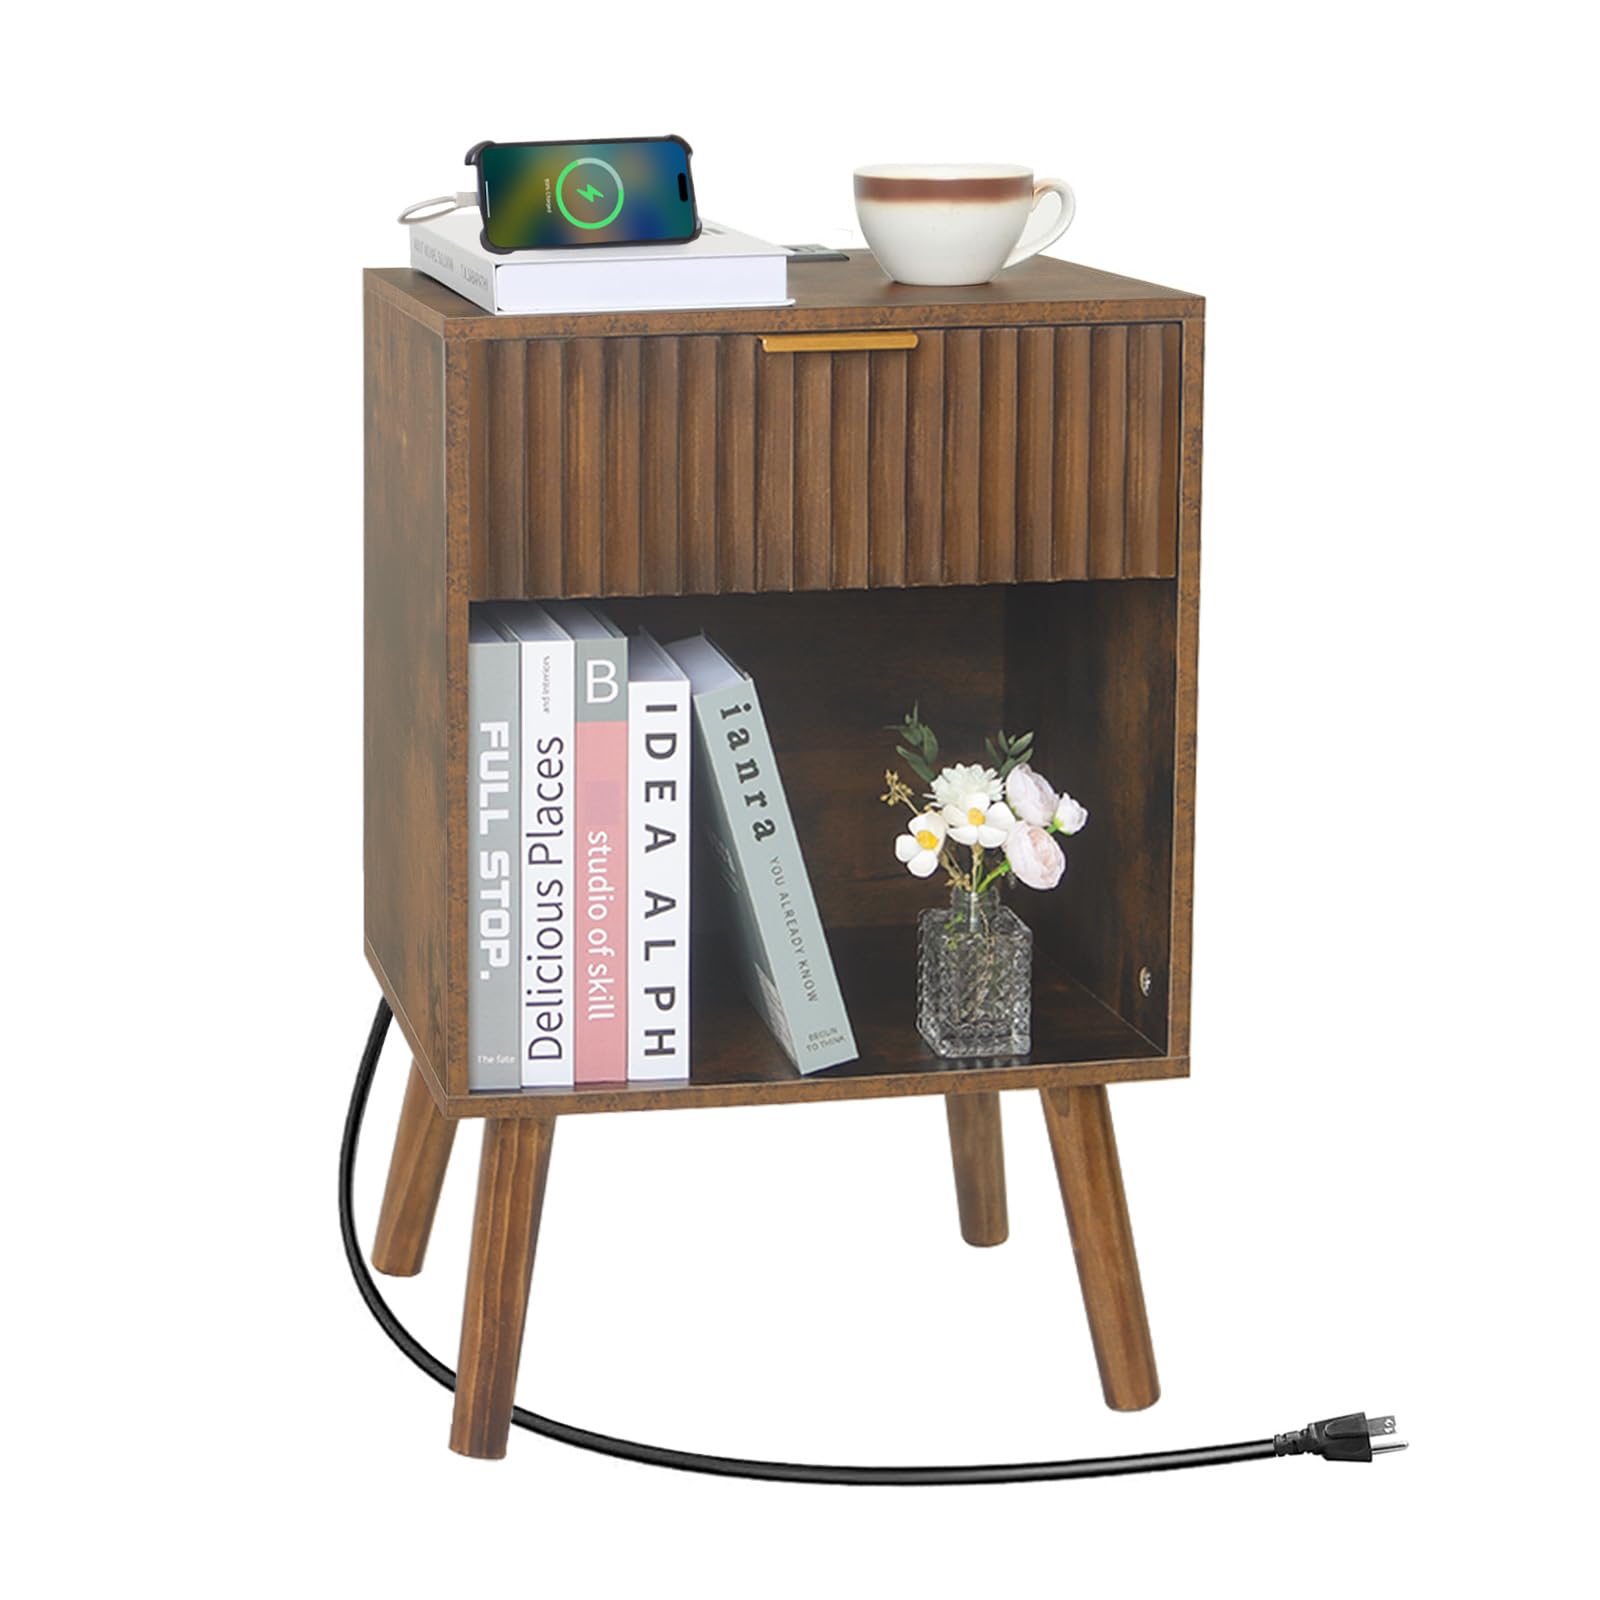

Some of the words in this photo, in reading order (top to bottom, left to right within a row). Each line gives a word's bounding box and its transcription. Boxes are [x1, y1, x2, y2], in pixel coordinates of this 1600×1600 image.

[586, 659, 620, 704] B
[479, 721, 509, 835] FULL
[525, 736, 564, 866] Places
[643, 703, 678, 854] IDEA
[720, 701, 776, 842] ianra
[479, 851, 510, 980] STOP.
[587, 831, 615, 920] studio
[770, 856, 785, 886] YOU
[779, 893, 805, 954] ALREADY
[799, 960, 818, 1002] KNOW
[525, 879, 564, 1061] Delicious
[587, 928, 615, 957] of
[587, 963, 615, 1020] skill
[643, 889, 678, 1057] ALPH
[806, 1042, 819, 1053] TO
